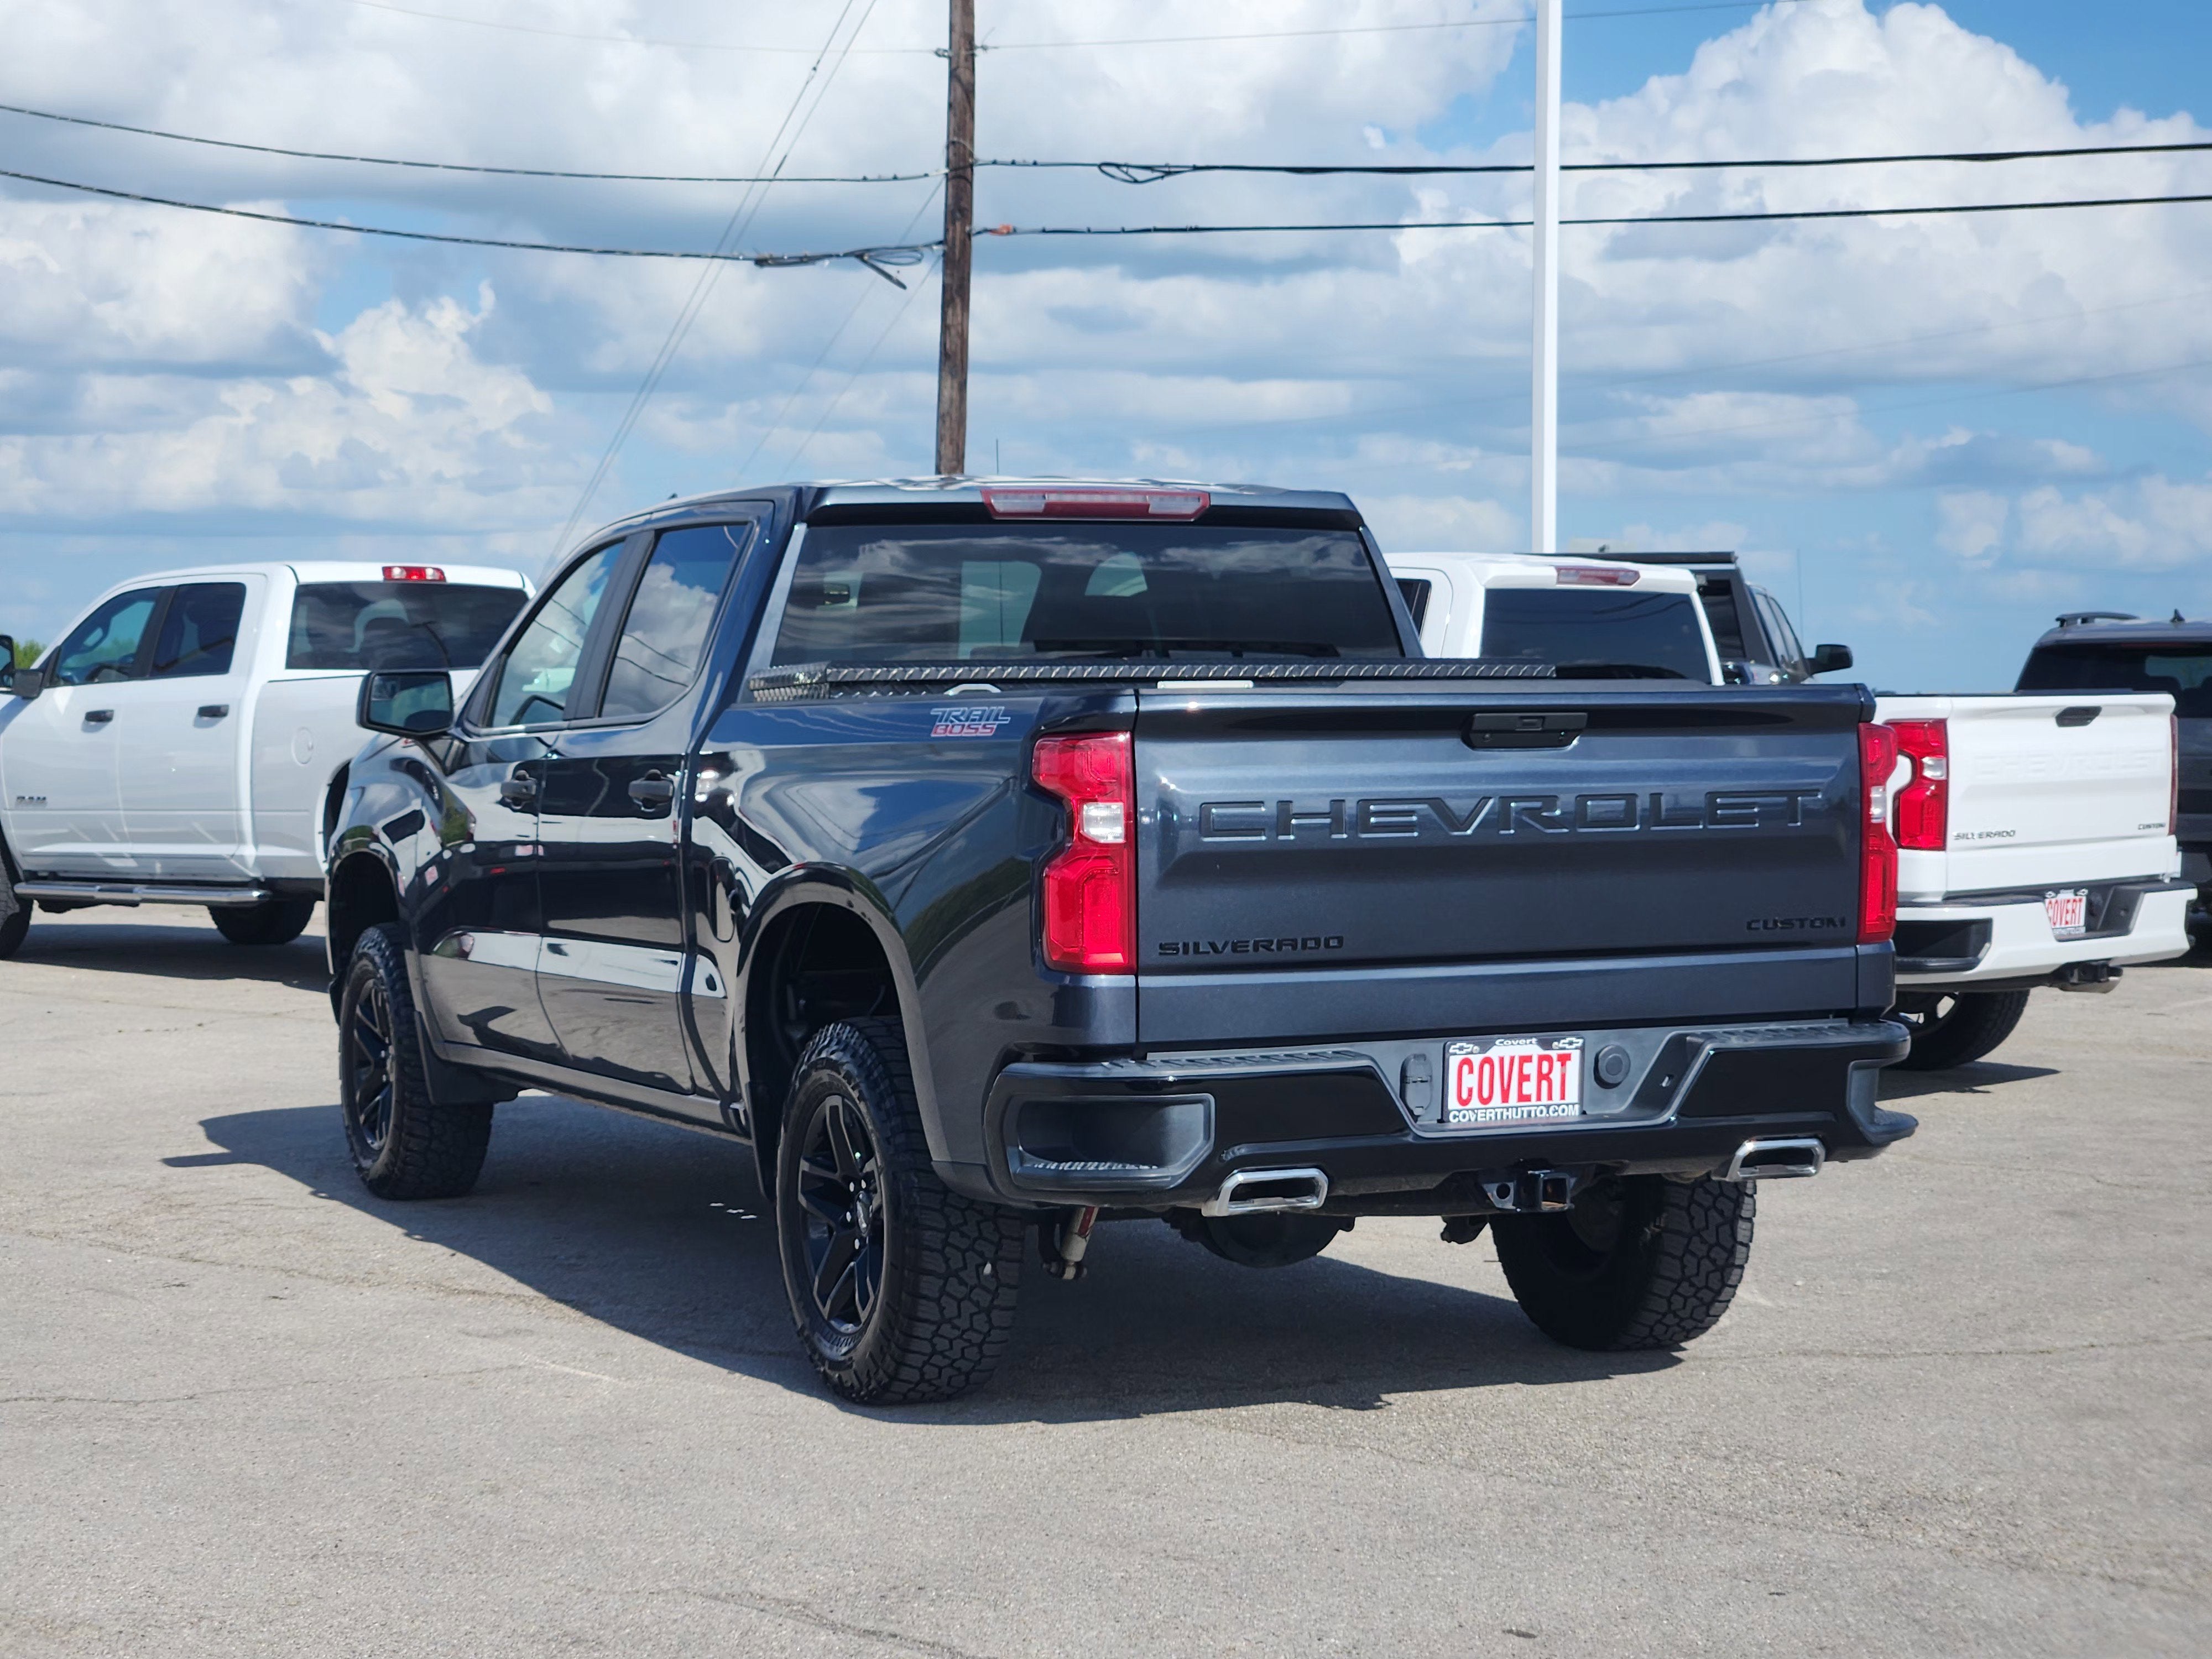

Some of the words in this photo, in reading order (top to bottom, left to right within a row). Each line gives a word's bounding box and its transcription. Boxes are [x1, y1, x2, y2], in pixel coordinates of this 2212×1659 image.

[930, 706, 1011, 724] TRAIL
[930, 723, 998, 737] BOSS
[1199, 789, 1822, 842] CHEVROLET
[1953, 830, 2016, 840] SILVERADO
[2046, 897, 2083, 927] COVERT
[1746, 916, 1846, 931] CUSTOM
[1158, 936, 1344, 956] SILVERADO
[1495, 1037, 1538, 1046] Covert
[1456, 1053, 1572, 1107] COVERT
[1449, 1104, 1580, 1123] COVERTHUTTO.COM
